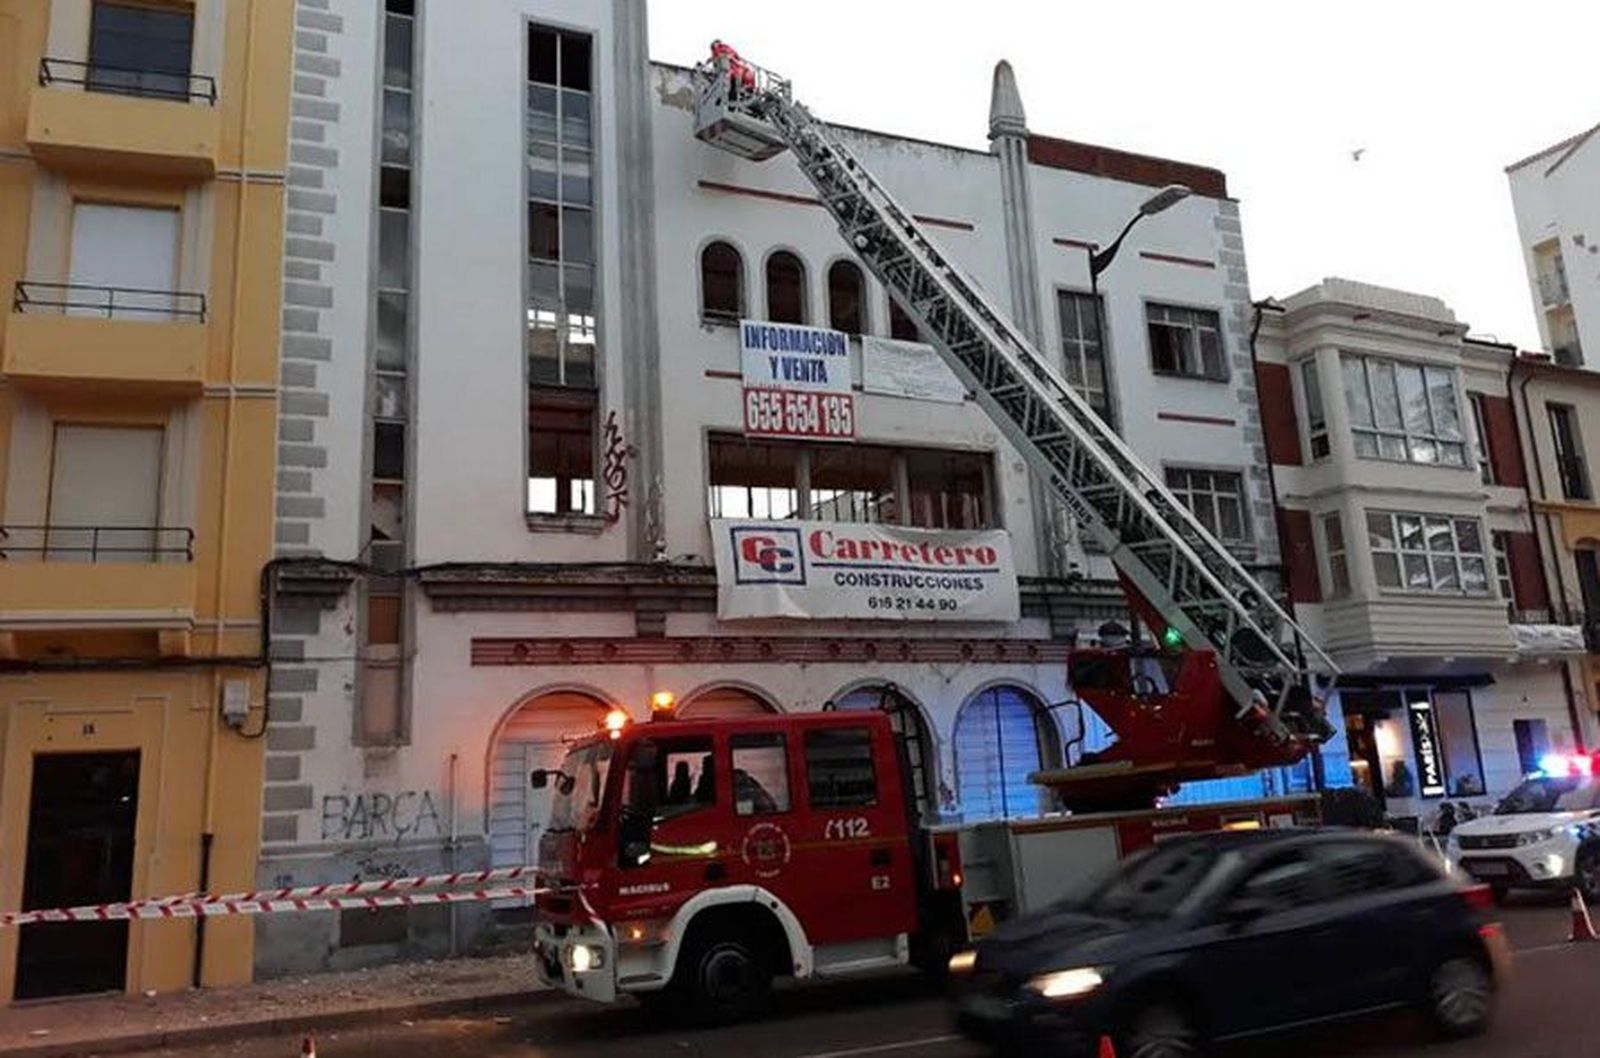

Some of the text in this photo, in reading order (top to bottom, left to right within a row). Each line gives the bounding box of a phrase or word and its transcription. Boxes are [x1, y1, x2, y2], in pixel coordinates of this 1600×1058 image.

[769, 356, 828, 383] Y VENTA
[747, 391, 853, 436] 655 554 135
[808, 529, 997, 566] Carretero
[834, 571, 984, 591] CONSTRUCCIONES
[895, 596, 911, 610] 21
[916, 597, 935, 610] 44
[939, 598, 957, 611] 90
[321, 789, 442, 843] BARÇA
[871, 875, 891, 890] E2
